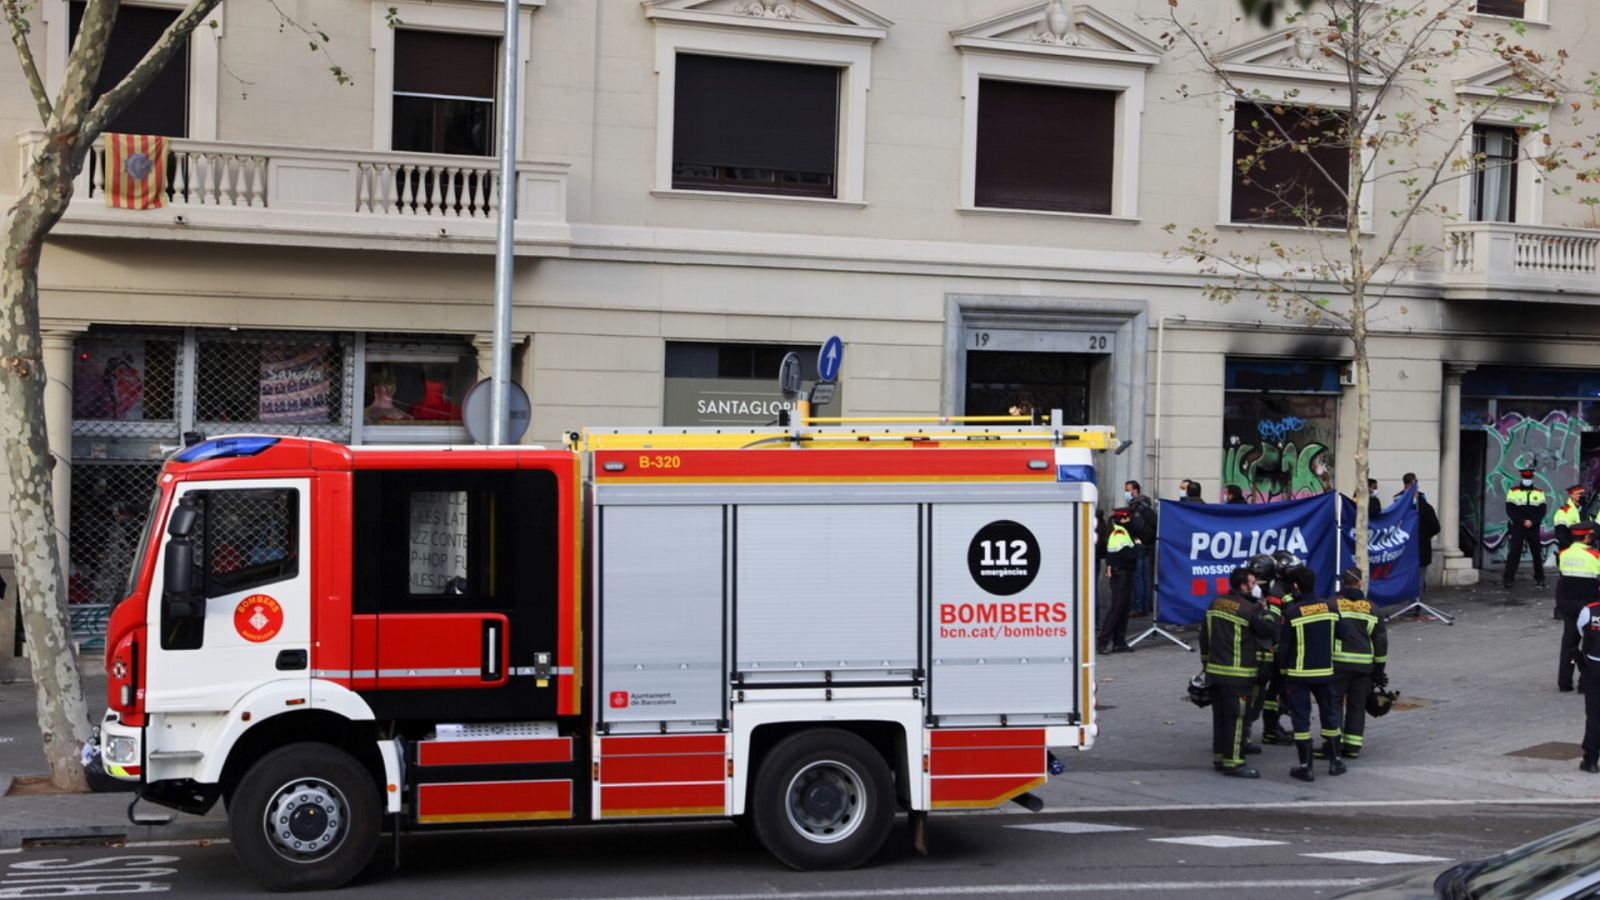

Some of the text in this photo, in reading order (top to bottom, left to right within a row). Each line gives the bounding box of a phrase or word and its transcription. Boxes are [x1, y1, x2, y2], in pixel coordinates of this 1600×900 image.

[975, 332, 990, 347] 19
[1088, 335, 1107, 350] 20
[640, 455, 681, 468] B-320
[1190, 526, 1308, 560] POLICIA
[980, 539, 1028, 566] 112
[1192, 564, 1237, 575] mossos
[237, 595, 280, 613] BOMBERS
[940, 602, 1068, 624] BOMBERS
[940, 625, 1067, 640] bcn.cat/bombers
[631, 692, 671, 700] Ajuntament
